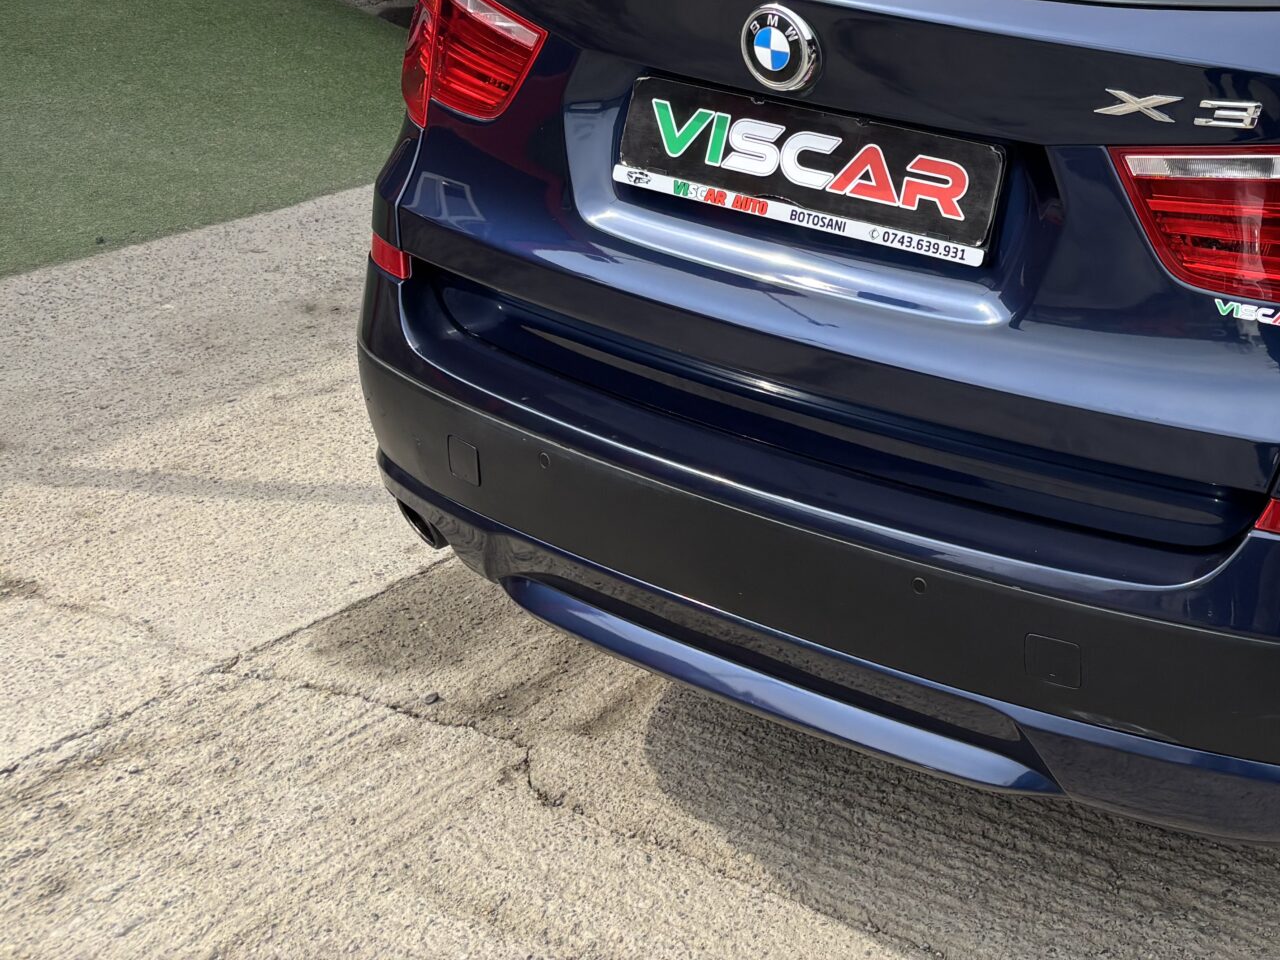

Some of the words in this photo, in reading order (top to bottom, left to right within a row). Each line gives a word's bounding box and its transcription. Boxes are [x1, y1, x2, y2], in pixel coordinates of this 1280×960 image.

[750, 14, 799, 42] BMW
[651, 98, 970, 221] VISCAR
[673, 180, 727, 206] VISCAR
[731, 194, 769, 215] AUTO
[789, 209, 847, 233] BOTOSANI
[882, 231, 966, 261] 0743.639.931
